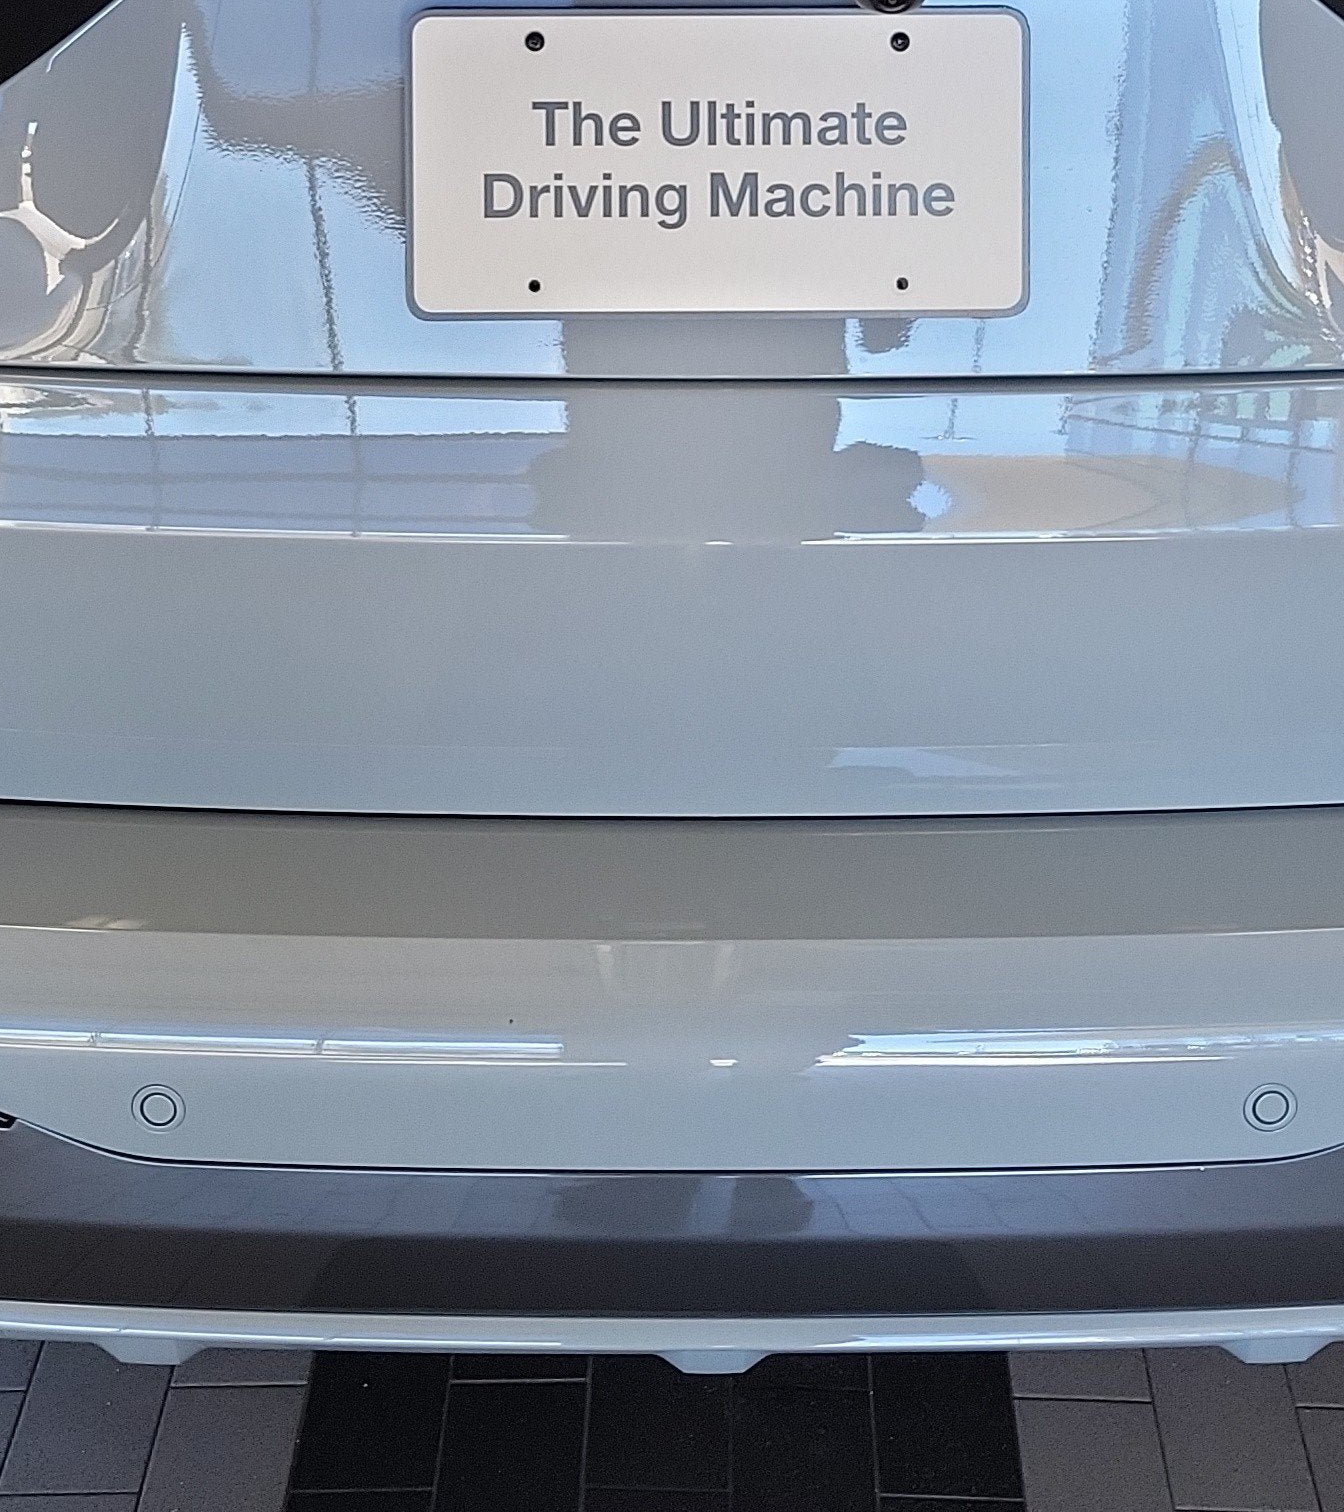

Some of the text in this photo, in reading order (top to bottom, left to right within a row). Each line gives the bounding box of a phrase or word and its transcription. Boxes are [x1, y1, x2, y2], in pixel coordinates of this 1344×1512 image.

[531, 99, 908, 147] The Ultimate
[482, 170, 956, 230] Driving Machine
